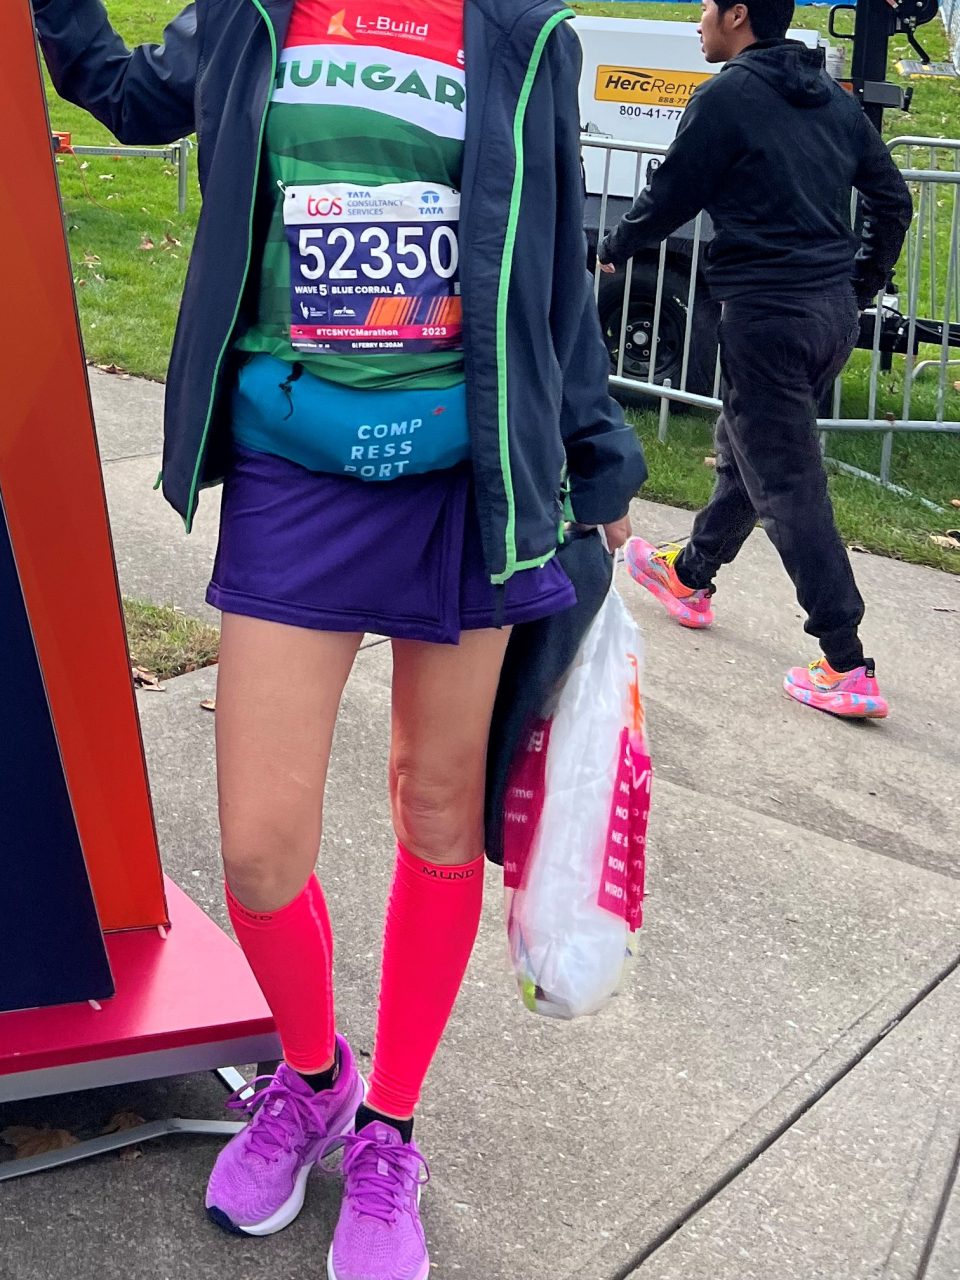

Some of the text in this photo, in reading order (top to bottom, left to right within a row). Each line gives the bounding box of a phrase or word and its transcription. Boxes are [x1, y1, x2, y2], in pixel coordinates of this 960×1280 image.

[356, 16, 429, 36] L-Build
[307, 195, 342, 217] tcs
[347, 208, 384, 216] SERVICES
[418, 207, 444, 215] TATA
[299, 225, 459, 280] 52350
[295, 283, 406, 296] WAVE 5 BLUE CORRAL A
[422, 327, 447, 336] 2023
[357, 418, 423, 440] COMP
[351, 440, 413, 460] RESS
[422, 866, 475, 880] MUND
